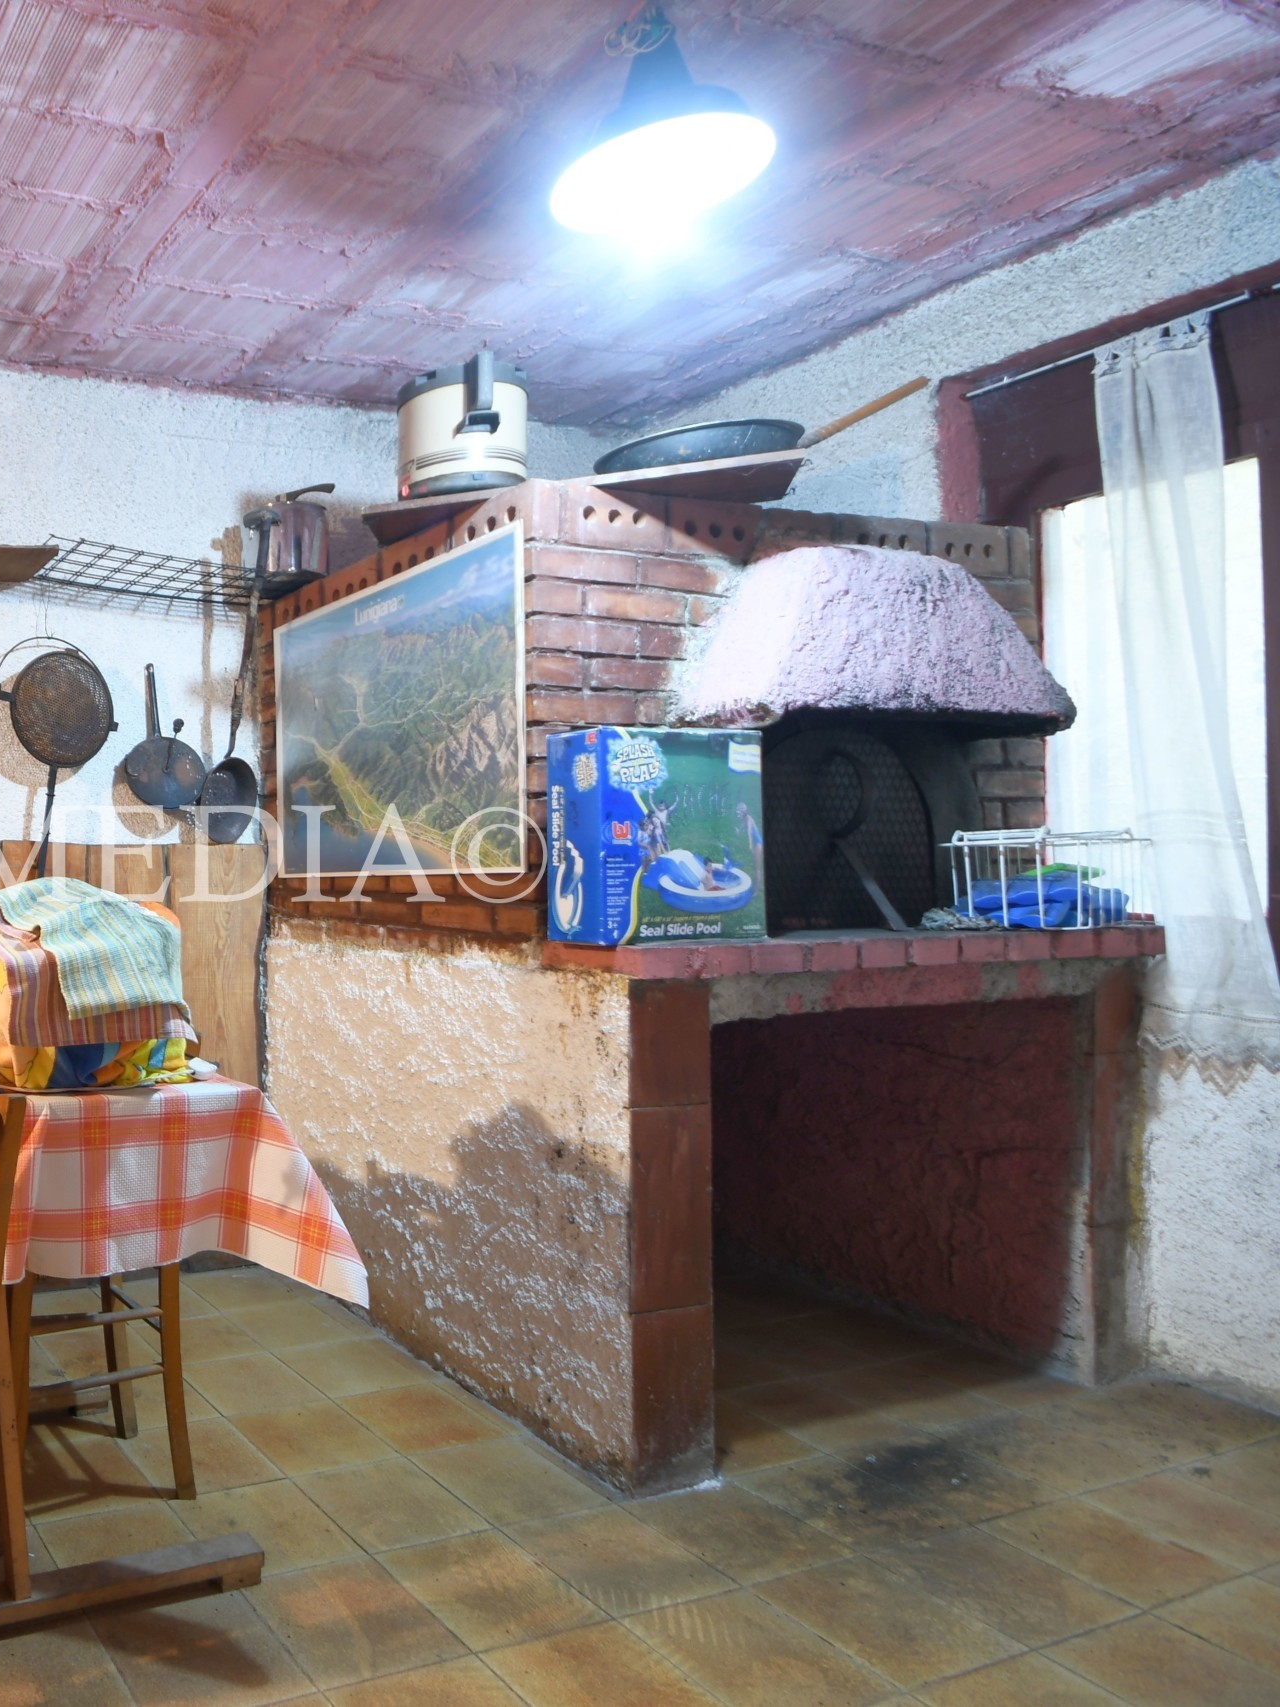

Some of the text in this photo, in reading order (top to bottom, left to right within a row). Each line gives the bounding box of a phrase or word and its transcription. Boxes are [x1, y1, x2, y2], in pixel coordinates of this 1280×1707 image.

[354, 597, 398, 626] Lunigiana
[617, 744, 655, 761] SPLASH
[620, 764, 659, 784] PLAY
[551, 786, 560, 867] Seal Slide Pool
[639, 922, 721, 937] Seal Slide Pool
